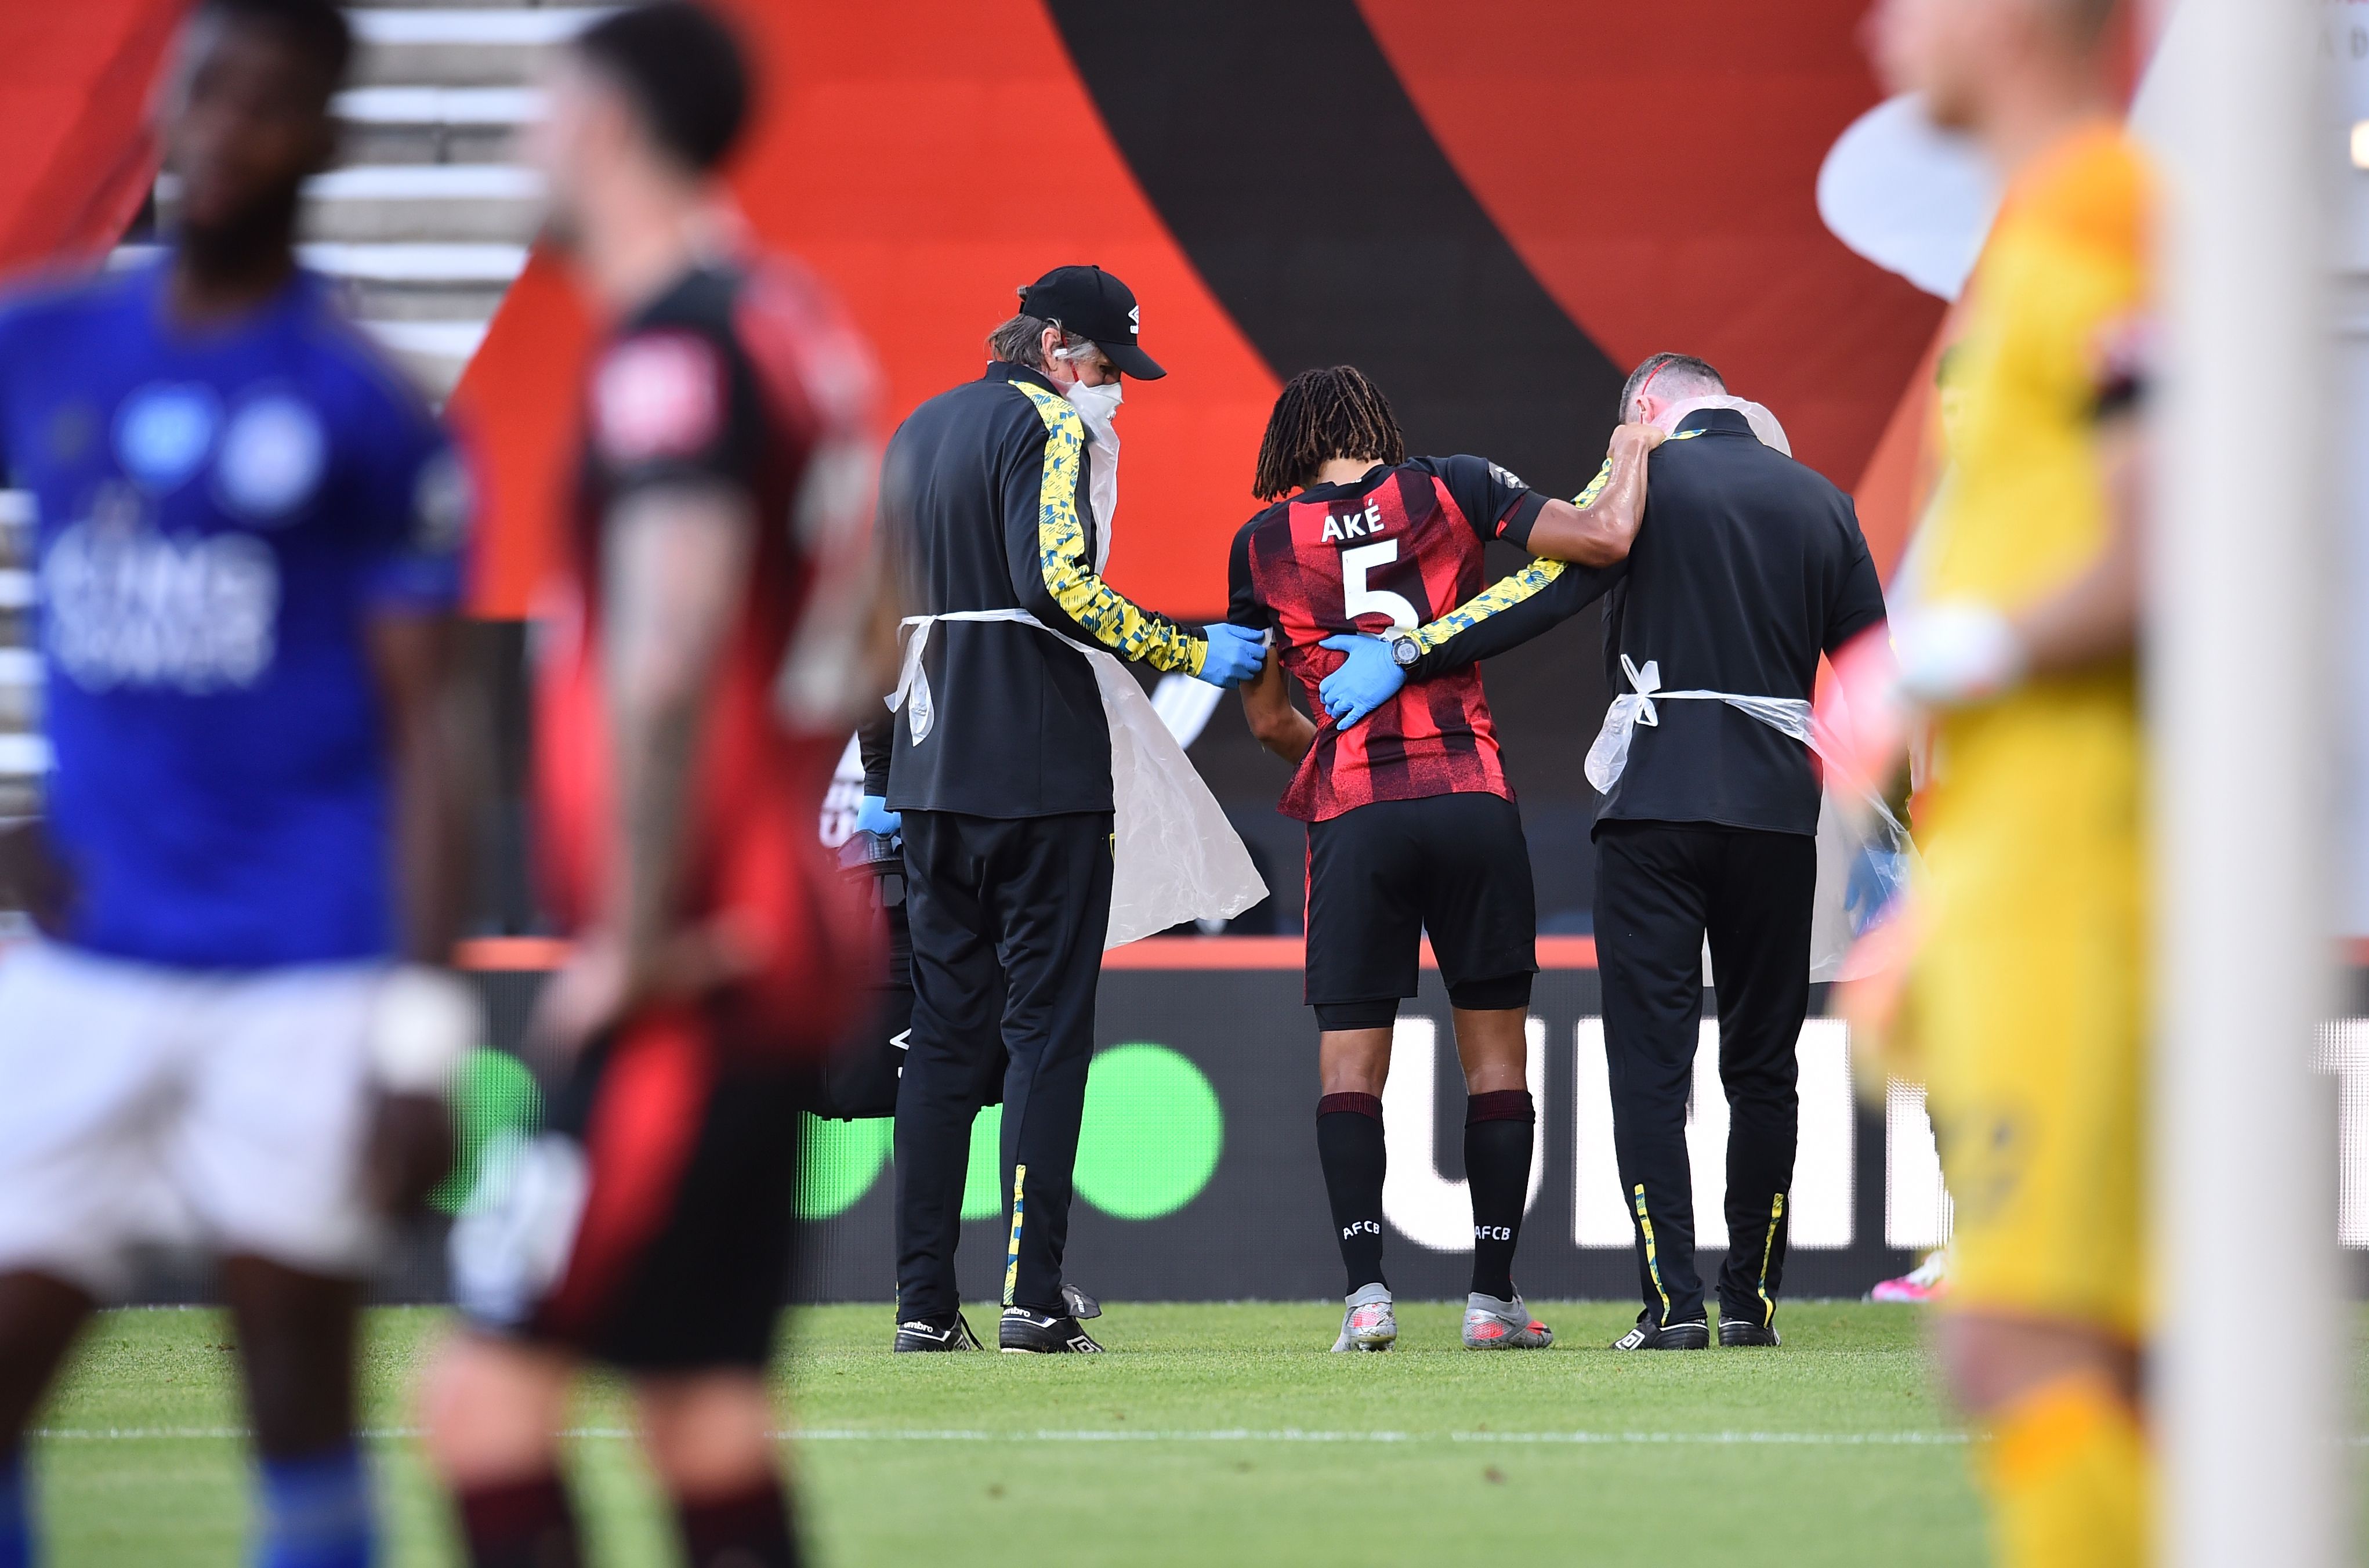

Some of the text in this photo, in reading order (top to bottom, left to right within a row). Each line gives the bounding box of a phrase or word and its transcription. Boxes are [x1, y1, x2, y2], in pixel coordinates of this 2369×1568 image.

[1321, 498, 1385, 542] AKÉ
[1342, 538, 1419, 642] 5
[1343, 1221, 1380, 1240] AFCB
[1475, 1225, 1511, 1241] AFCB
